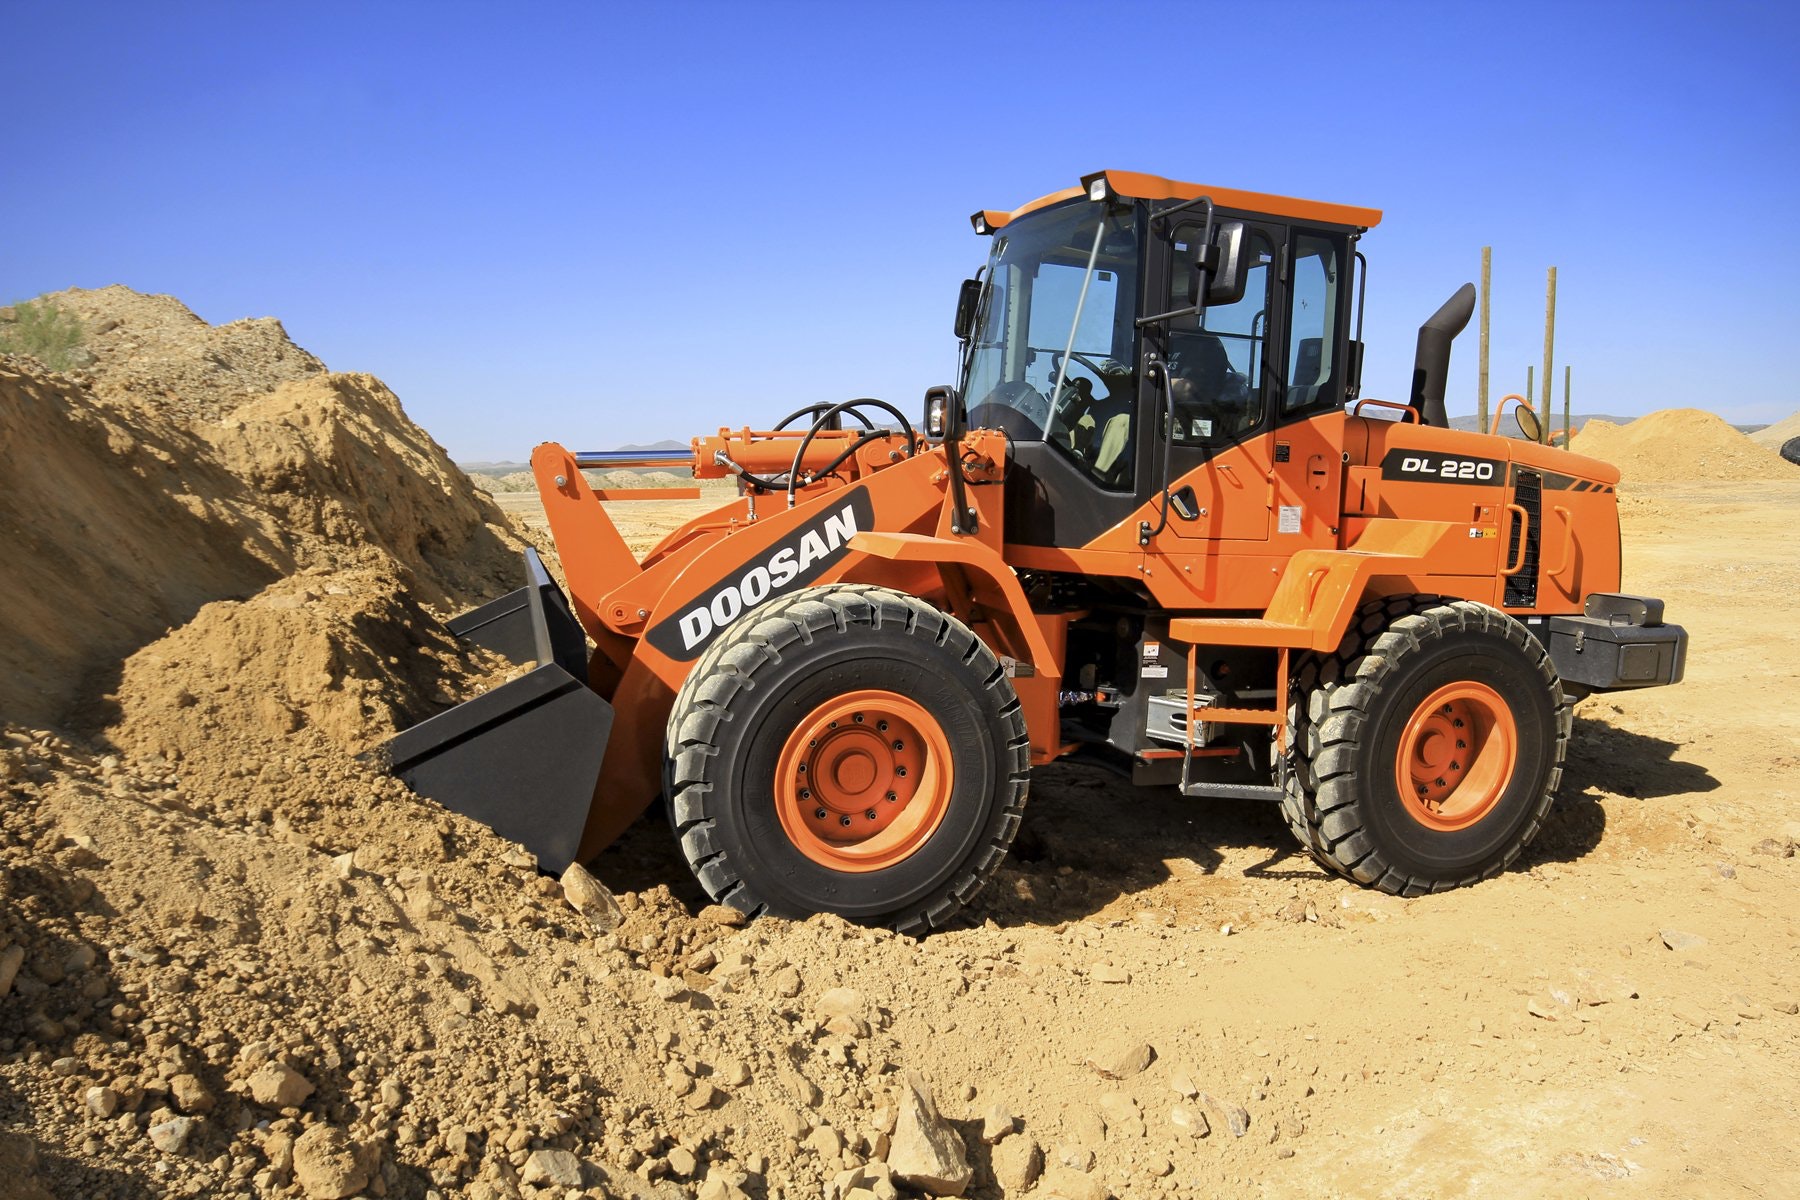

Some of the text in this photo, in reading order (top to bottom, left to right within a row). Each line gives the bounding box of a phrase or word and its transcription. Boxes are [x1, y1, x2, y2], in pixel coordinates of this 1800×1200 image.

[1402, 458, 1493, 480] DL 220
[679, 504, 858, 650] DOOSAN
